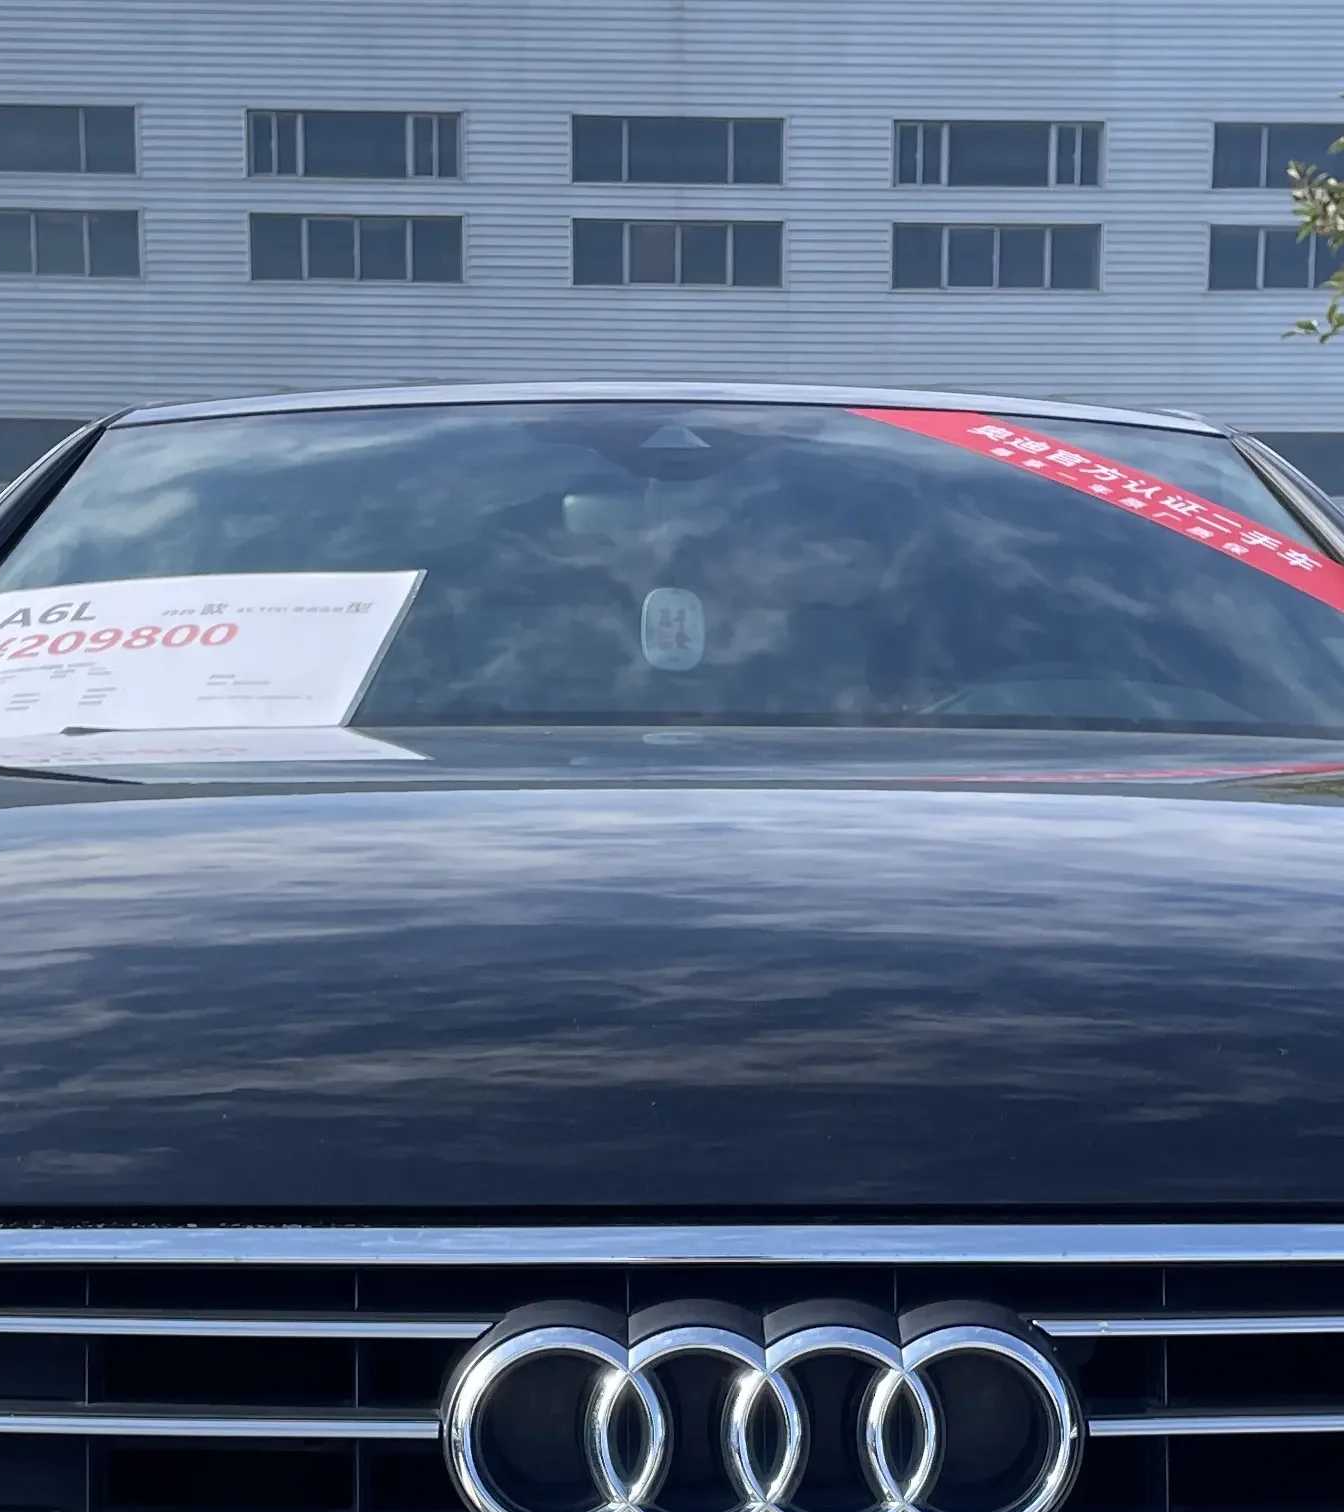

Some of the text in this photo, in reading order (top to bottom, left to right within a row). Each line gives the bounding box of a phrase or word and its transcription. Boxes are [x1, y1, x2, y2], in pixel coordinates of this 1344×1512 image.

[966, 424, 1323, 572] 奥迪官方认证二手车
